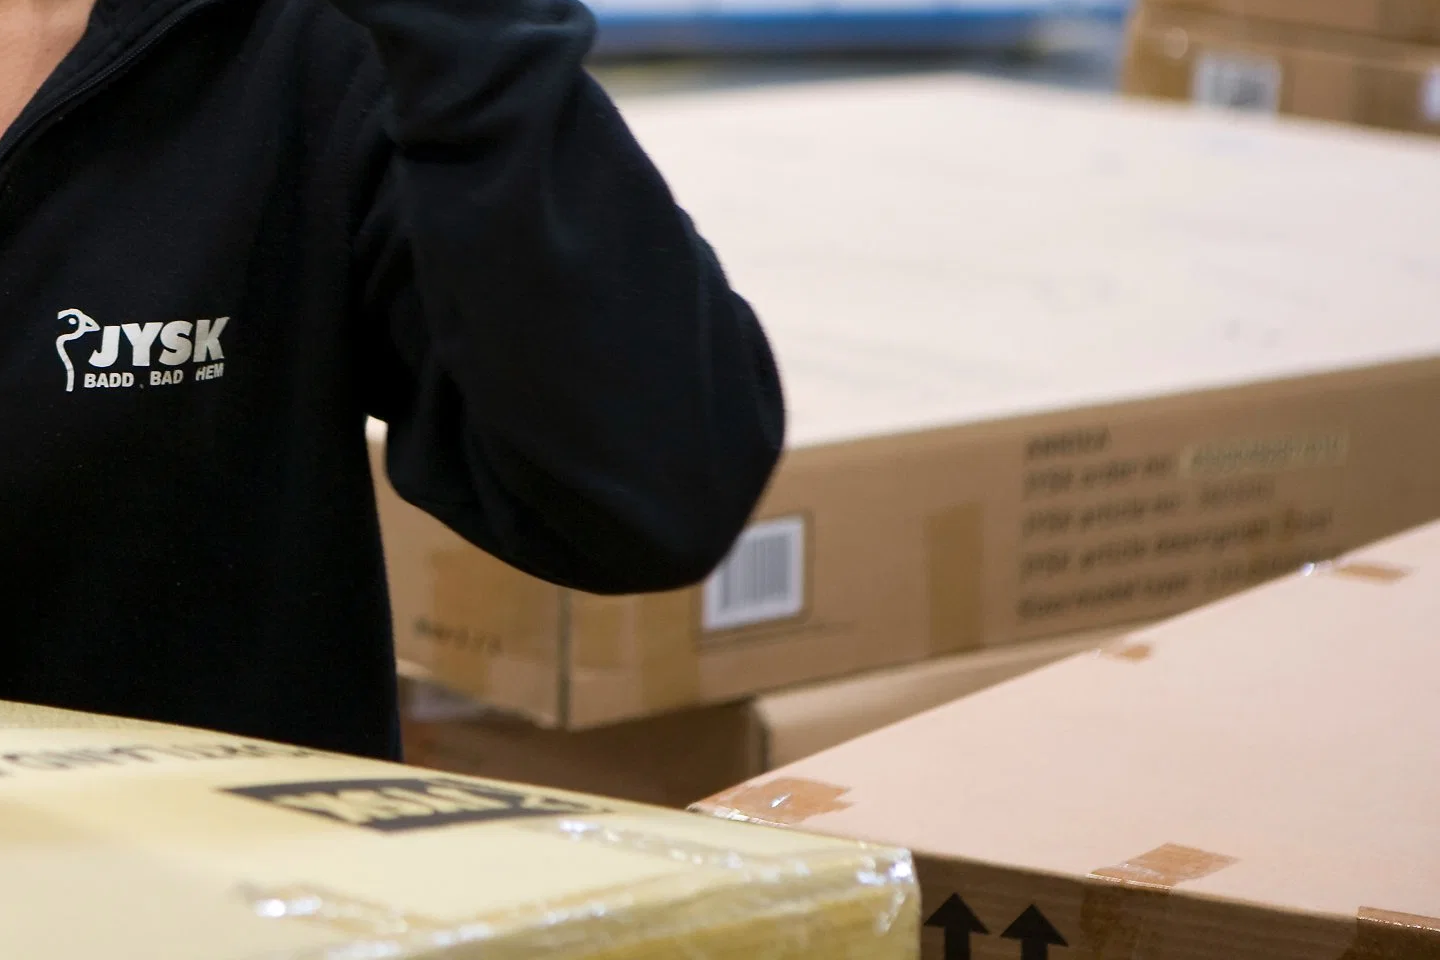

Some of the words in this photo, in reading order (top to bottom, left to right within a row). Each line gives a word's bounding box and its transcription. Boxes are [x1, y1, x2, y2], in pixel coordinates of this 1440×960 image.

[88, 316, 230, 367] JYSK
[149, 369, 184, 386] BAD
[195, 363, 225, 381] HEM
